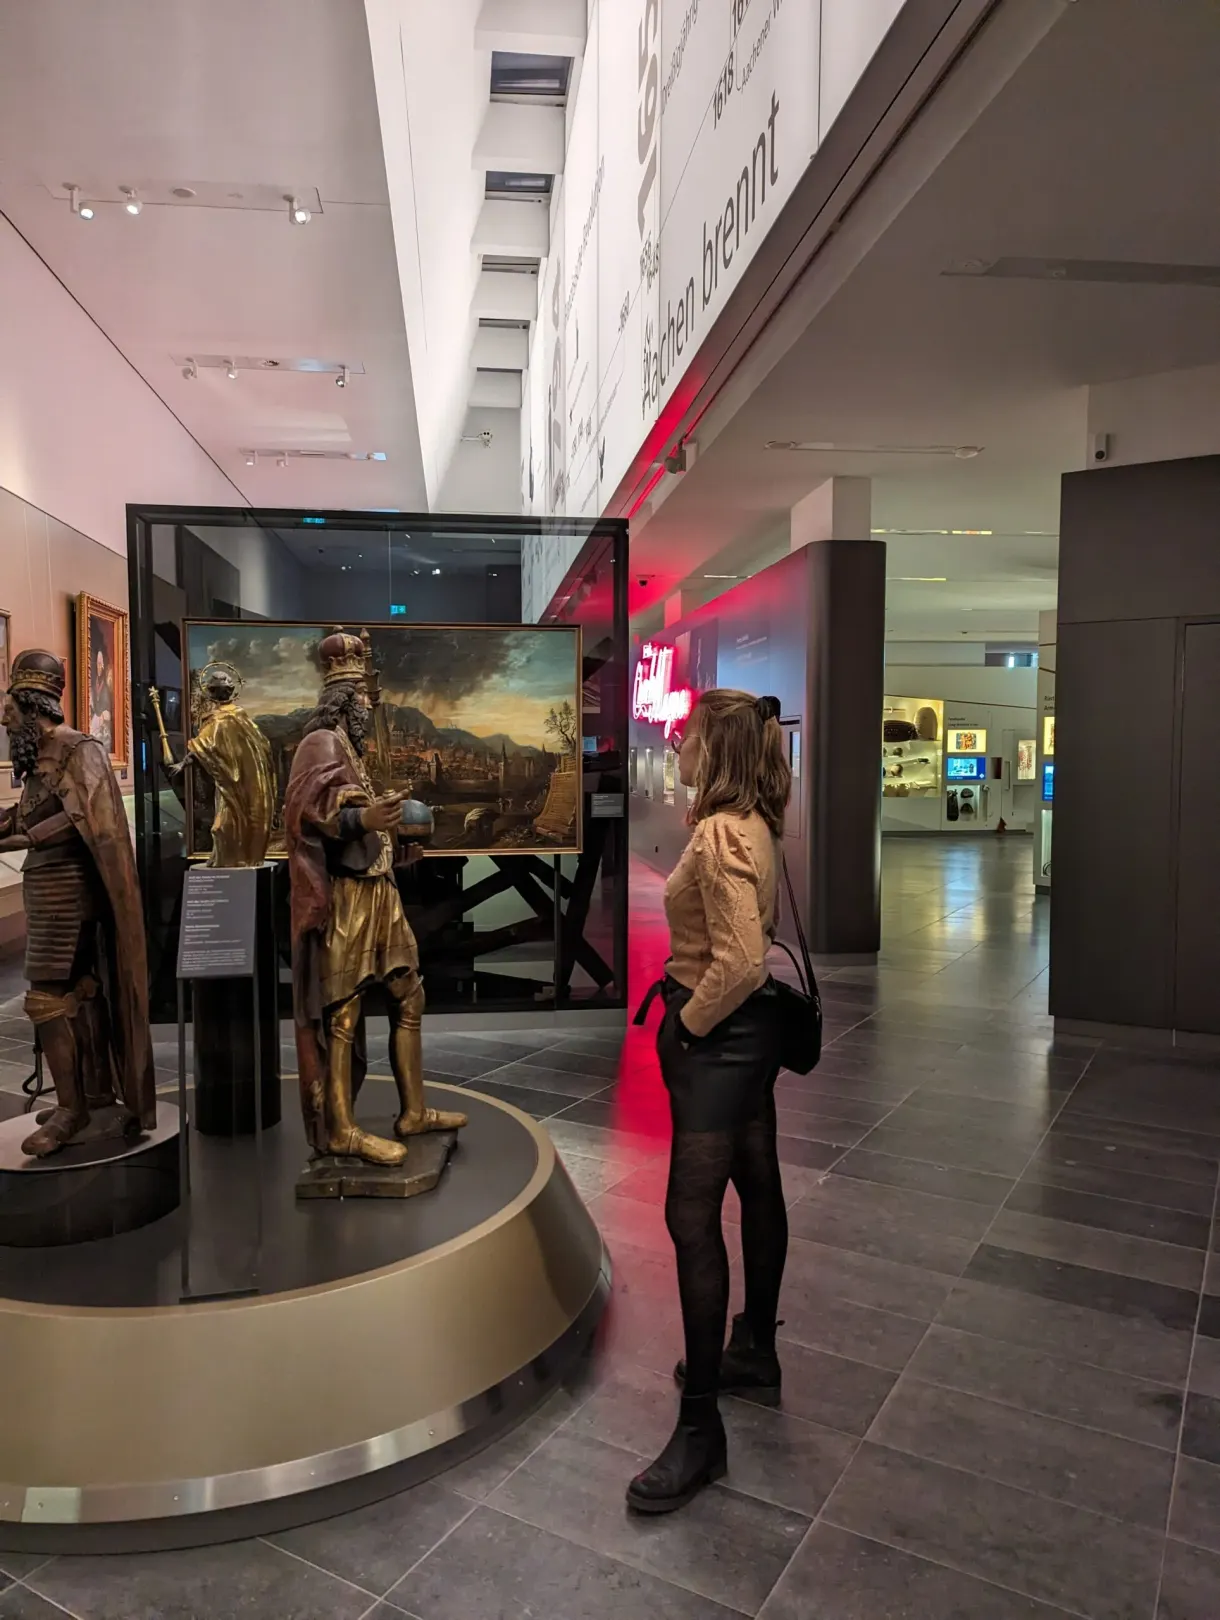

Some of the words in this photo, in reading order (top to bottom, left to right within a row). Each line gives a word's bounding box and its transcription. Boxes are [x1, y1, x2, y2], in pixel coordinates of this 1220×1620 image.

[713, 51, 734, 130] 1618
[642, 276, 695, 421] Aachen
[701, 88, 780, 312] brennt
